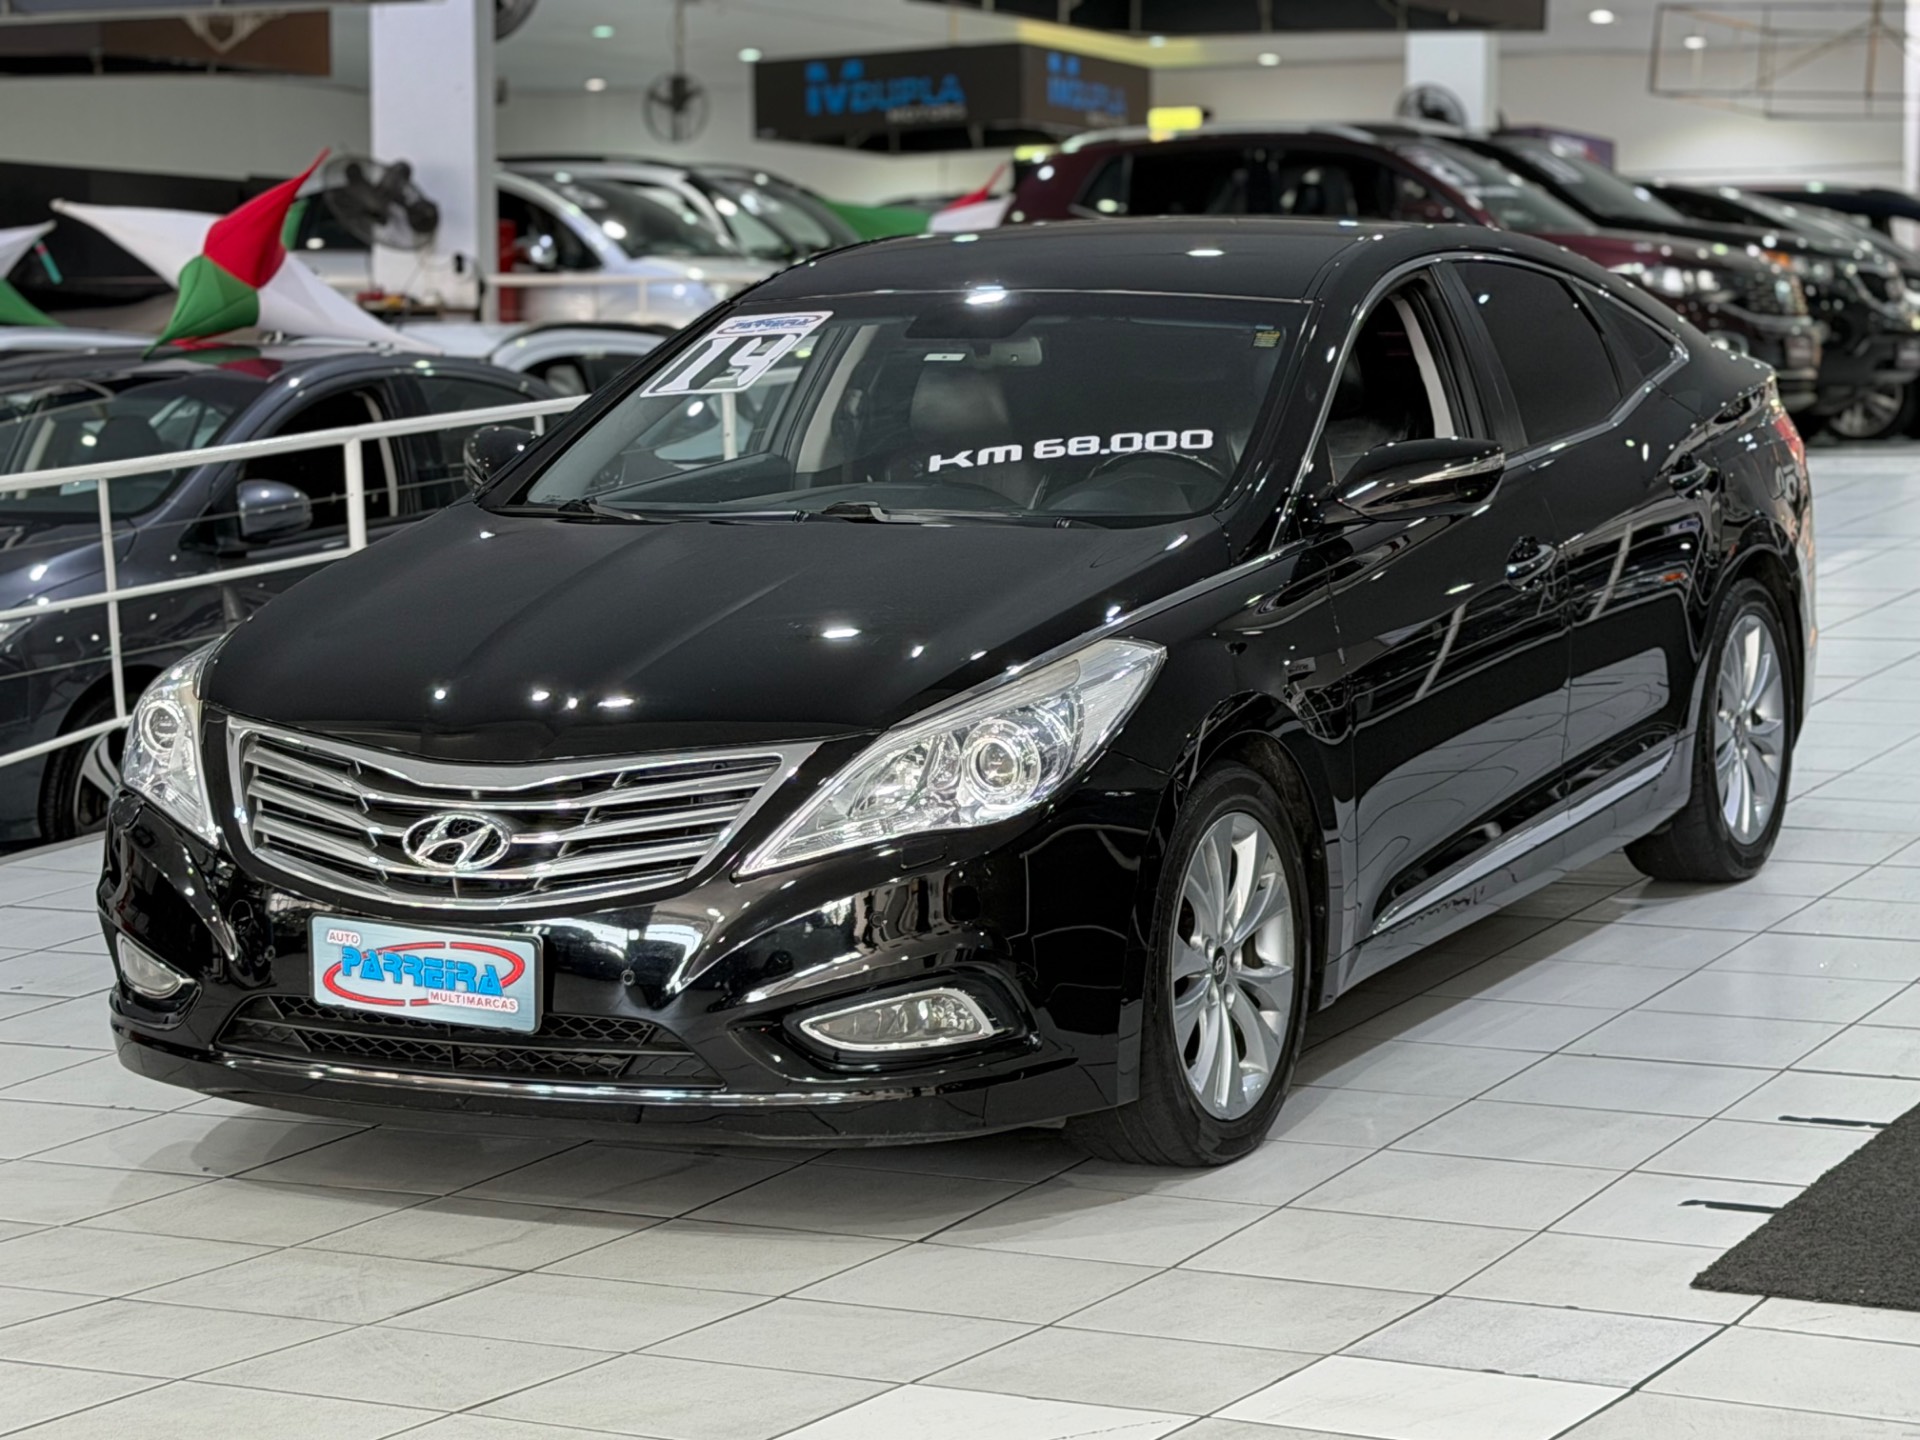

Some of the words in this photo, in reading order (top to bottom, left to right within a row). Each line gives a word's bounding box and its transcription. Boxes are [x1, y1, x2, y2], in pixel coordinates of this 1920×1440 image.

[1033, 429, 1214, 460] 68.000
[329, 931, 359, 945] AUTO
[341, 946, 504, 997] PARREIRA
[430, 991, 517, 1011] MULTIMARCAS
